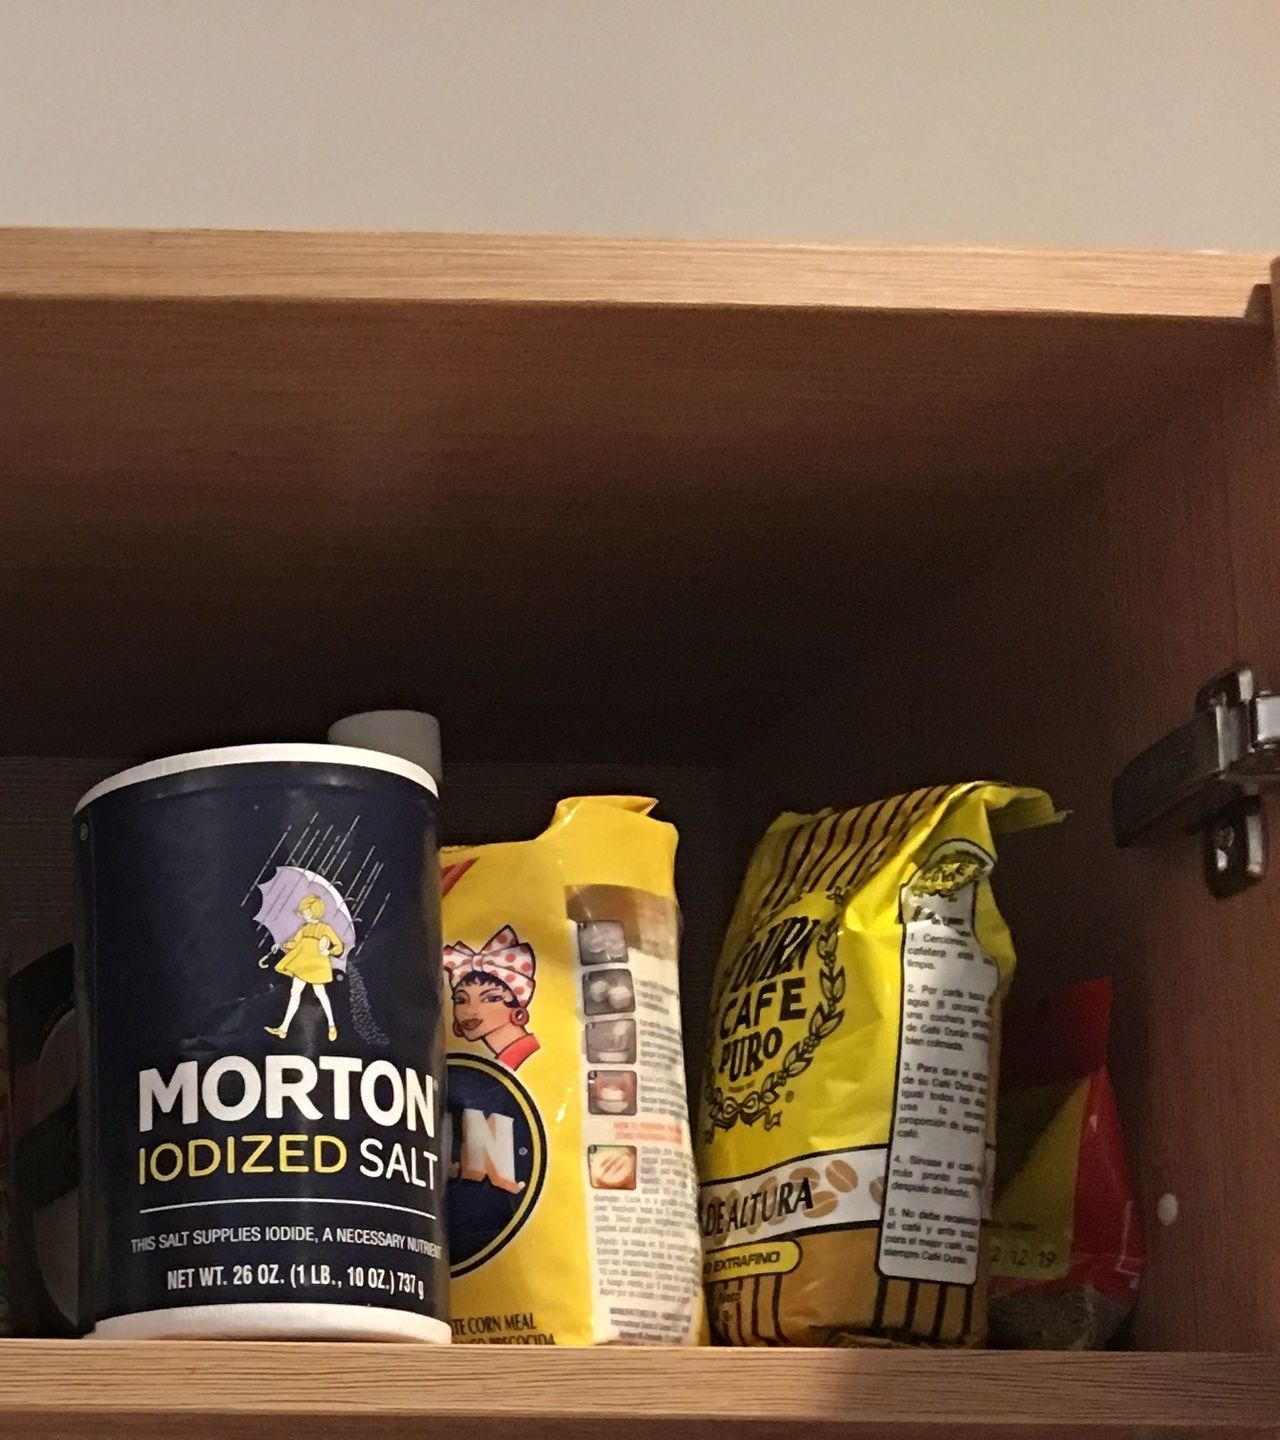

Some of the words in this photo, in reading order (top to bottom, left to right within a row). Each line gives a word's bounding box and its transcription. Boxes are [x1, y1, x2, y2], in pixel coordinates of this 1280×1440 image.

[719, 977, 807, 1040] CAFE
[719, 1026, 783, 1082] PURO
[140, 1055, 436, 1138] MORTON
[140, 1134, 348, 1185] IODIZED
[359, 1137, 439, 1191] SALT
[727, 1177, 814, 1232] ALTURA
[131, 1235, 156, 1253] THIS
[158, 1231, 190, 1249] SALT
[192, 1226, 262, 1245] SUPPLIES
[265, 1226, 319, 1244] IODIDE,
[322, 1227, 334, 1242] A
[336, 1228, 406, 1250] NECESSARY
[712, 1250, 782, 1273] EXTRAFINO
[167, 1268, 195, 1290] NET
[199, 1265, 228, 1287] WT.
[232, 1265, 253, 1285] 26
[257, 1264, 285, 1284] OZ.
[290, 1264, 305, 1288] (1
[347, 1266, 364, 1287] 10
[367, 1267, 395, 1295] OZ.)
[397, 1272, 416, 1294] 737
[467, 1314, 503, 1335] CORN
[503, 1312, 538, 1331] MEAL
